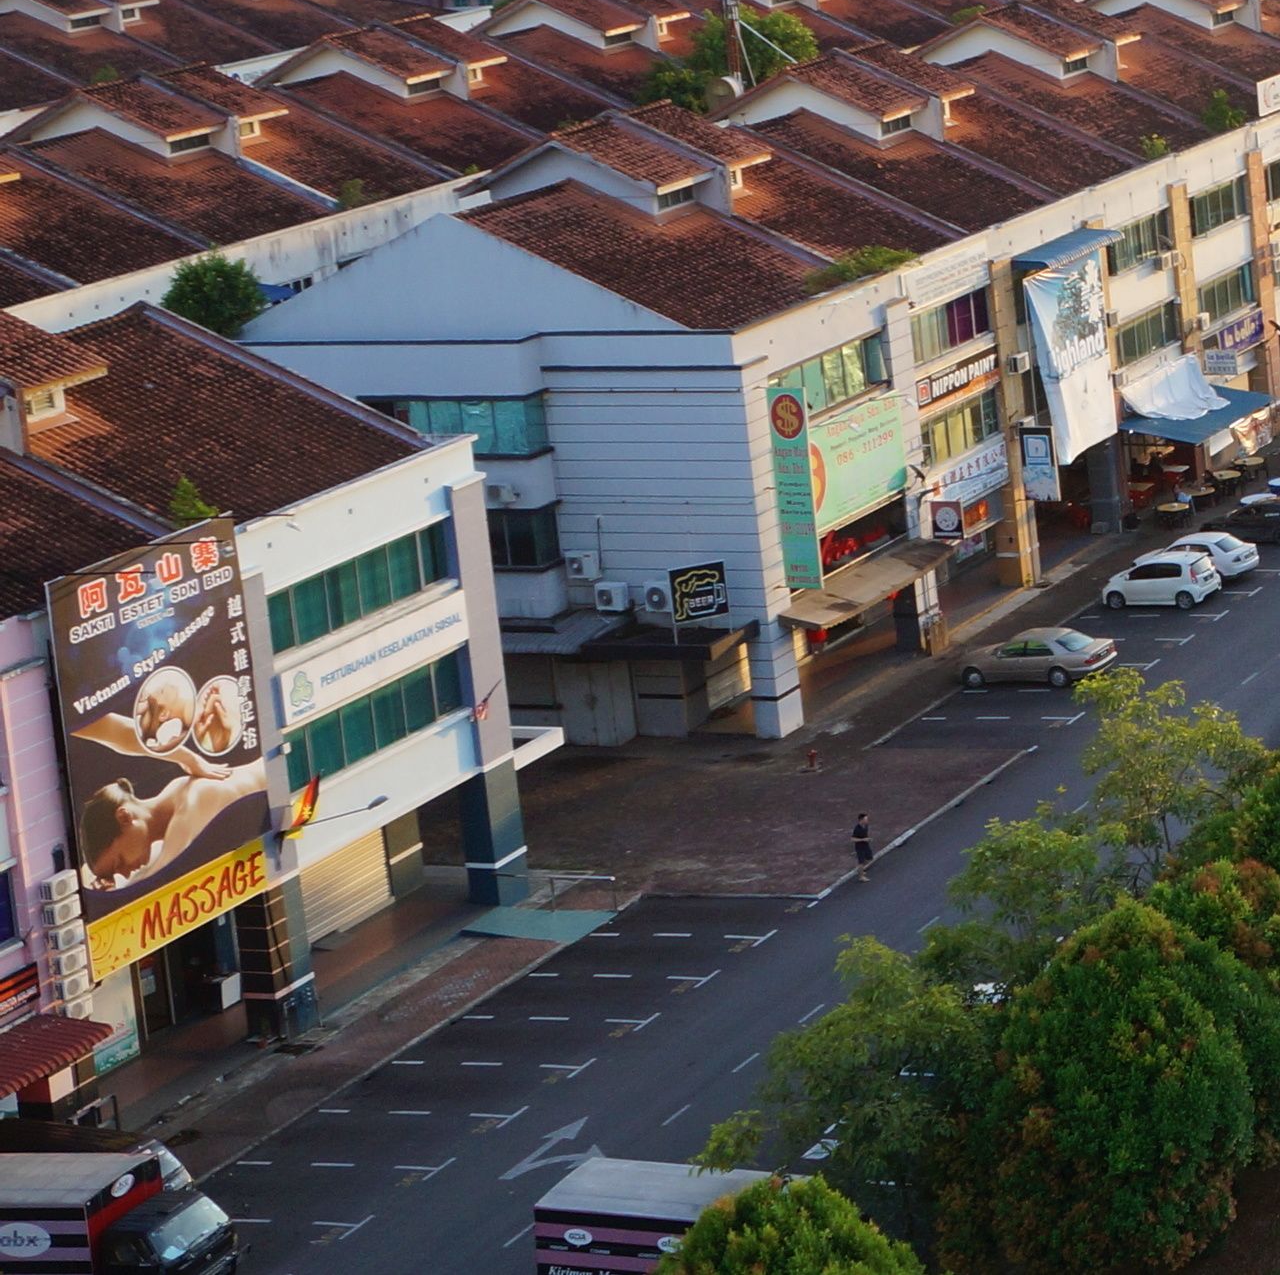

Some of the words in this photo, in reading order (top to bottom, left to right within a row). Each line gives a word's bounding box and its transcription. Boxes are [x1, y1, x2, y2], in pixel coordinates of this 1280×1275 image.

[932, 366, 968, 398] NIPPON
[968, 354, 997, 381] PAINT
[69, 613, 116, 644] SAKTI
[119, 593, 165, 624] ESTET
[169, 579, 200, 604] SDN
[203, 566, 234, 591] BHD
[78, 536, 219, 619] 阿瓦山寨
[689, 595, 714, 608] BEER
[73, 675, 131, 715] Vietnam
[133, 648, 166, 678] Style
[167, 605, 216, 652] Massage
[320, 652, 378, 688] PERTUBUHAN
[377, 627, 434, 662] KESELAMATAN
[434, 613, 462, 634] SOSIAL
[140, 850, 266, 949] MASSAGE
